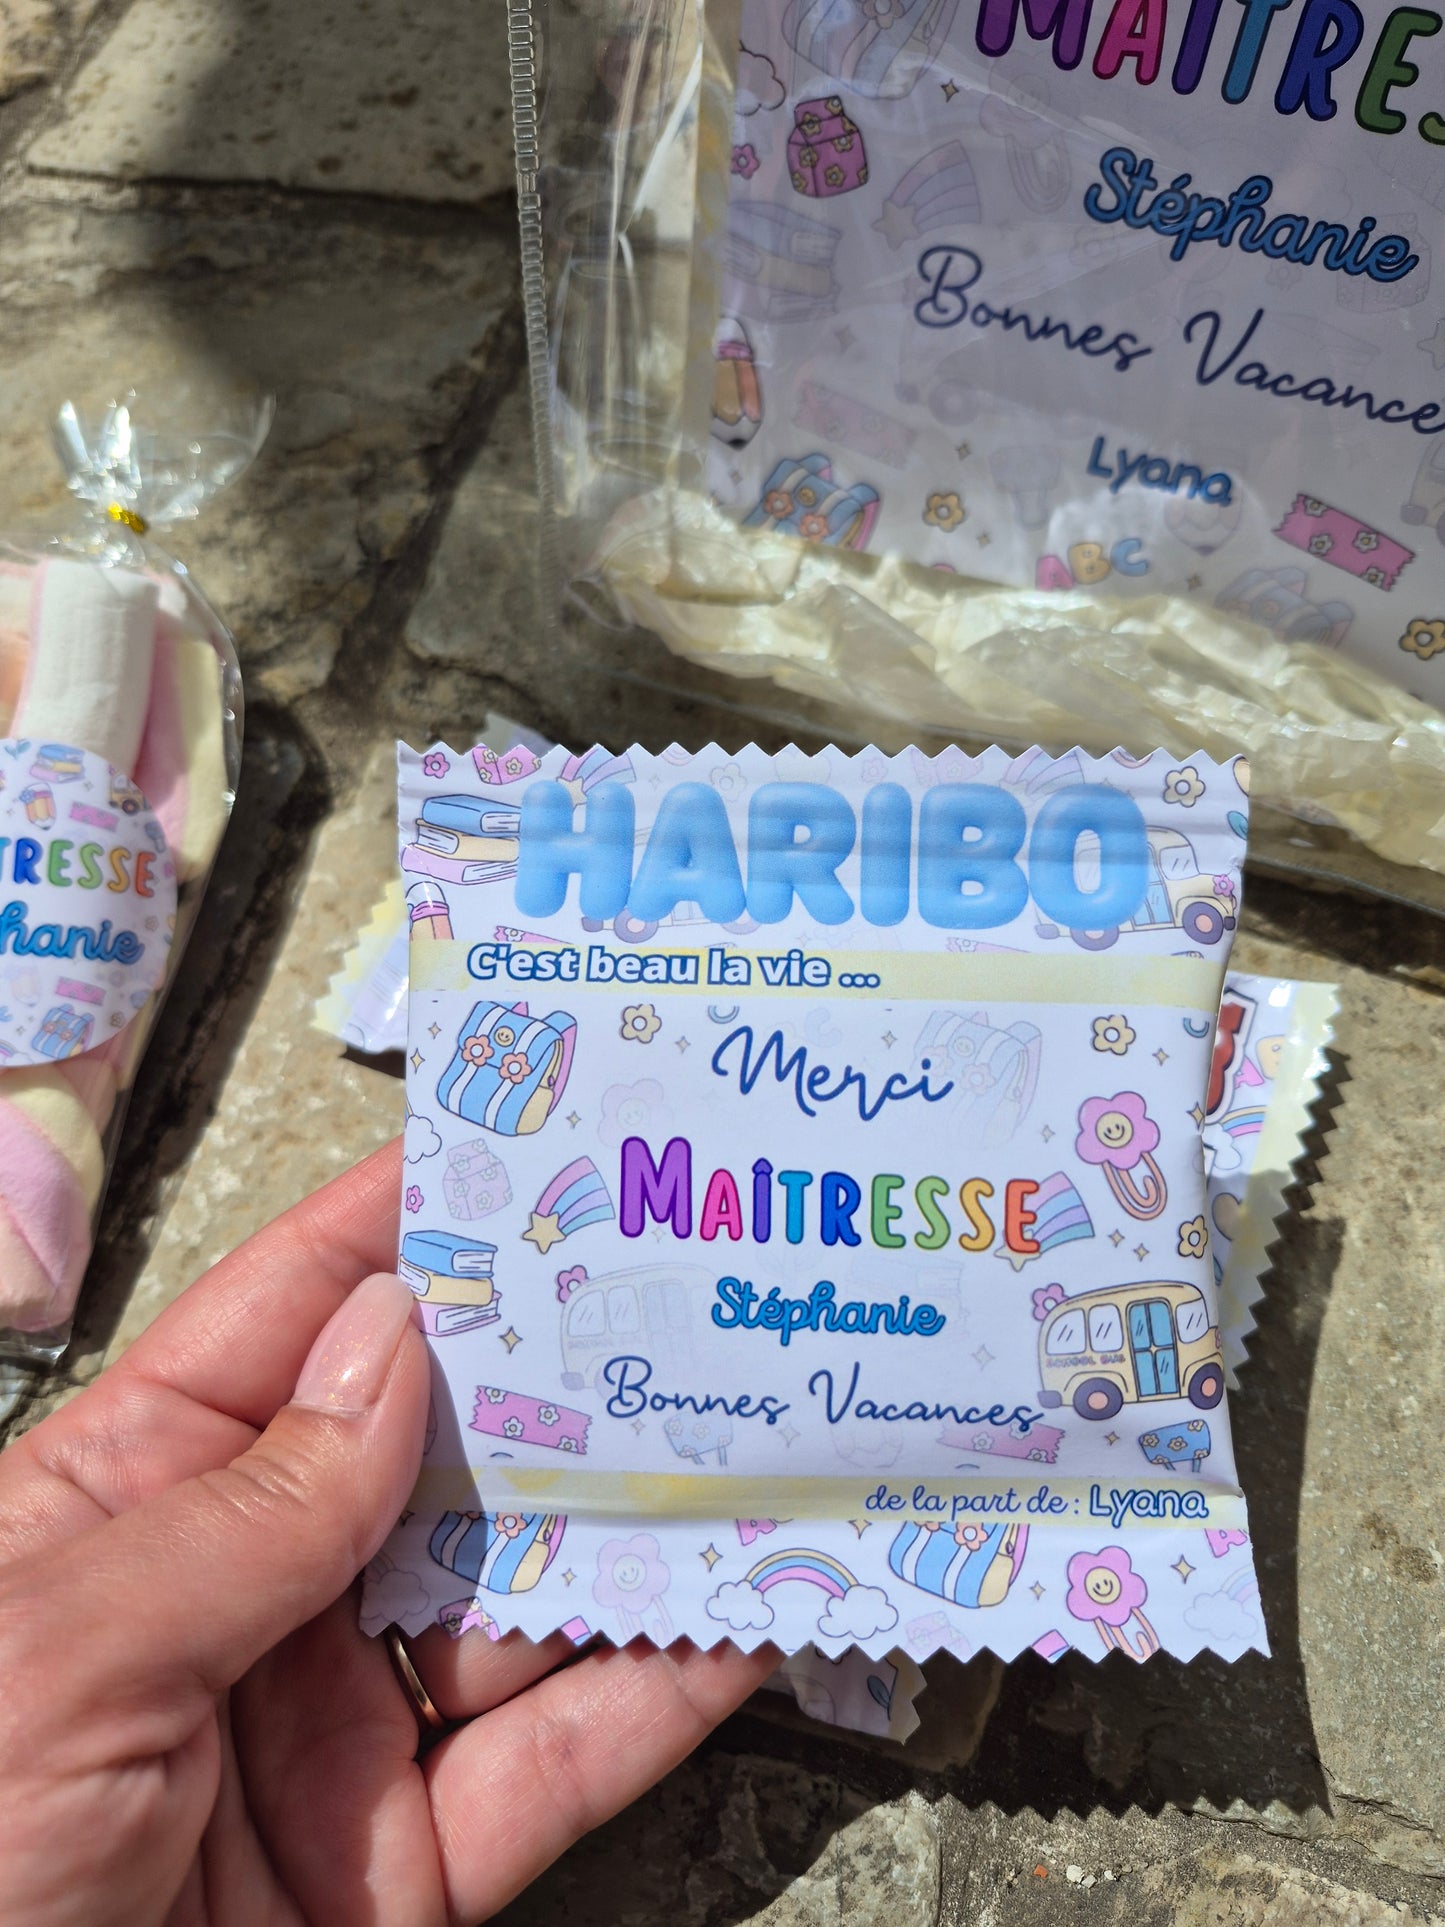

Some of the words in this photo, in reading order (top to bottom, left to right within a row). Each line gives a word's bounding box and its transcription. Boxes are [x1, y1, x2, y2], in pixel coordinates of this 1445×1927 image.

[1083, 147, 1419, 284] Stéphanie
[913, 244, 1152, 372] Bonnes
[1086, 435, 1233, 507] Lyana
[514, 779, 1151, 931] HARIBO
[467, 943, 580, 982] C'est
[585, 945, 701, 984] beau
[706, 948, 752, 986] la
[757, 949, 832, 988] vie
[711, 1025, 955, 1119] Merci
[712, 1276, 946, 1346] Stéphanie
[603, 1355, 791, 1425] Bonnes
[808, 1361, 1045, 1433] Vacances
[865, 1485, 907, 1511] de
[912, 1485, 946, 1512] la
[951, 1487, 1021, 1521] part
[1026, 1485, 1068, 1514] de
[1089, 1483, 1209, 1528] Lyana
